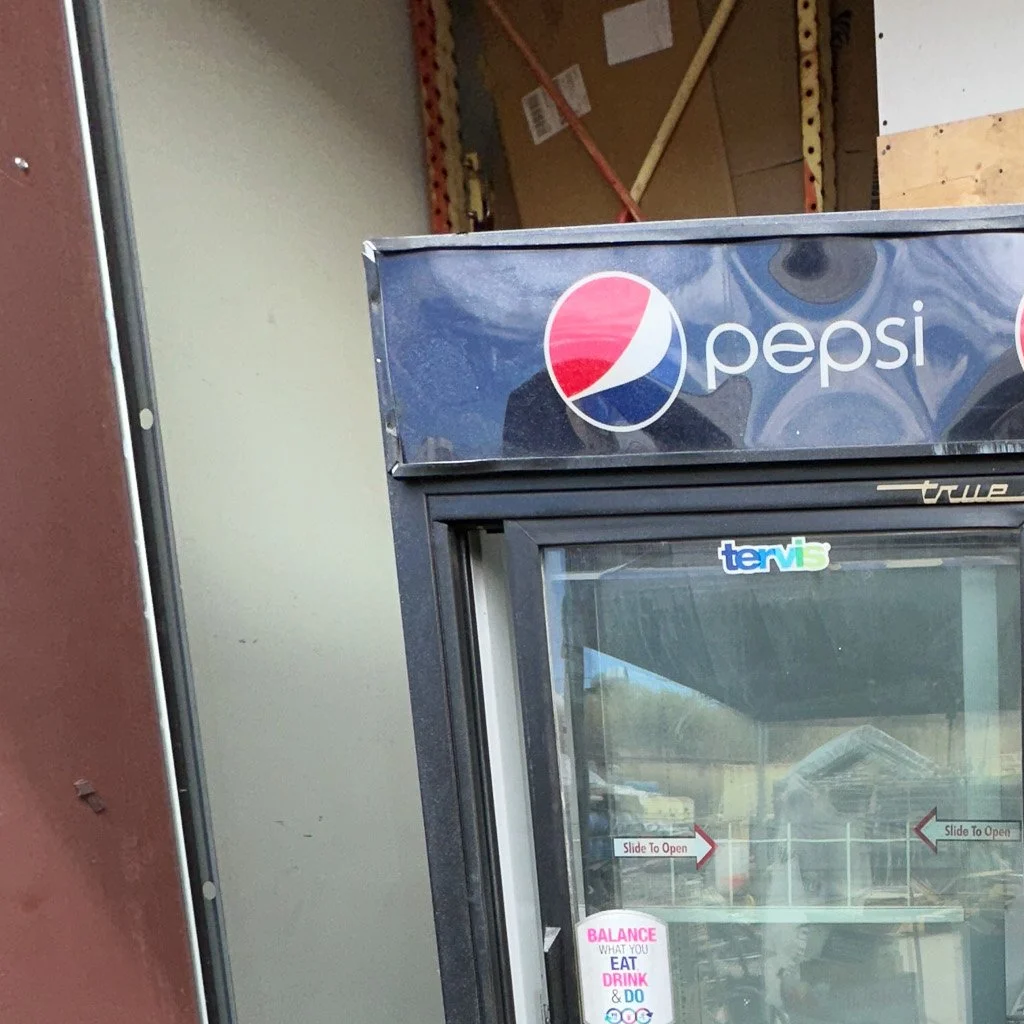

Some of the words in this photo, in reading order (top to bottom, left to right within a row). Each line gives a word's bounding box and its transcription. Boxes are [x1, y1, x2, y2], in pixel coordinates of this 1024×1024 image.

[705, 299, 928, 390] pepsi
[721, 537, 827, 571] tervis
[945, 824, 970, 837] Slide
[971, 824, 982, 837] To
[984, 825, 1011, 840] Open
[623, 842, 647, 854] Slide
[649, 842, 660, 854] To
[662, 842, 688, 856] Open
[587, 927, 658, 943] BALANCE
[599, 944, 626, 955] WHAT
[629, 944, 649, 955] YOU
[610, 956, 637, 971] EAT
[602, 972, 649, 987] DRINK
[611, 988, 622, 1004] &
[624, 988, 645, 1004] DO
